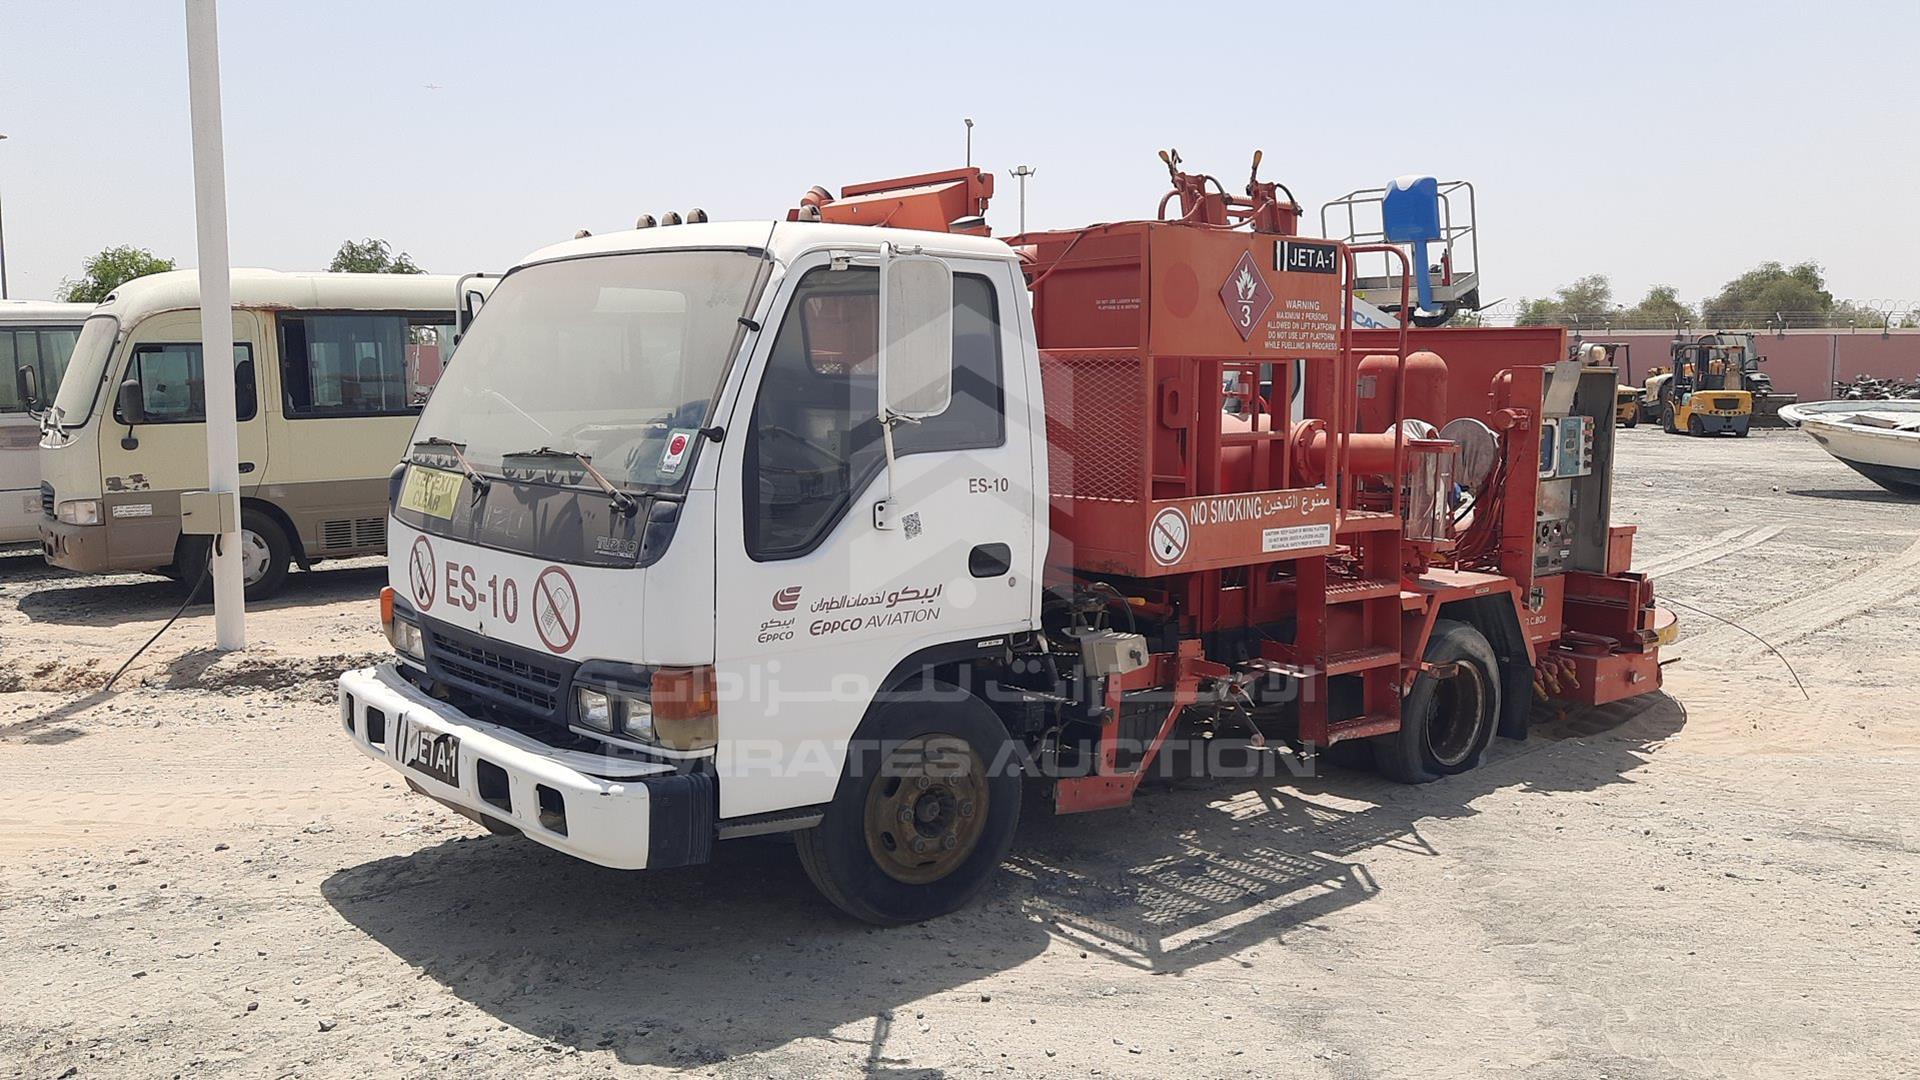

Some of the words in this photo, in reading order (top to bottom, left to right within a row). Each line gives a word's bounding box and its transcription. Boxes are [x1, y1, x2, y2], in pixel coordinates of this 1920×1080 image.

[1285, 299, 1320, 311] WARNING
[1240, 305, 1251, 327] 3
[1267, 320, 1292, 329] ALLOWED
[1300, 321, 1311, 330] LIFT
[1311, 322, 1337, 331] PLATFORM
[1267, 330, 1276, 339] DO
[1276, 331, 1287, 339] NOT
[968, 477, 1009, 494] ES-10
[1190, 500, 1208, 526] NO
[1209, 496, 1262, 525] SMOKING
[1264, 495, 1298, 515] التدخين
[1301, 492, 1330, 515] ممنوع
[445, 560, 519, 625] ES-10
[808, 618, 863, 637] EPPCO
[864, 607, 942, 630] AVIATION
[757, 631, 794, 644] EPPCO
